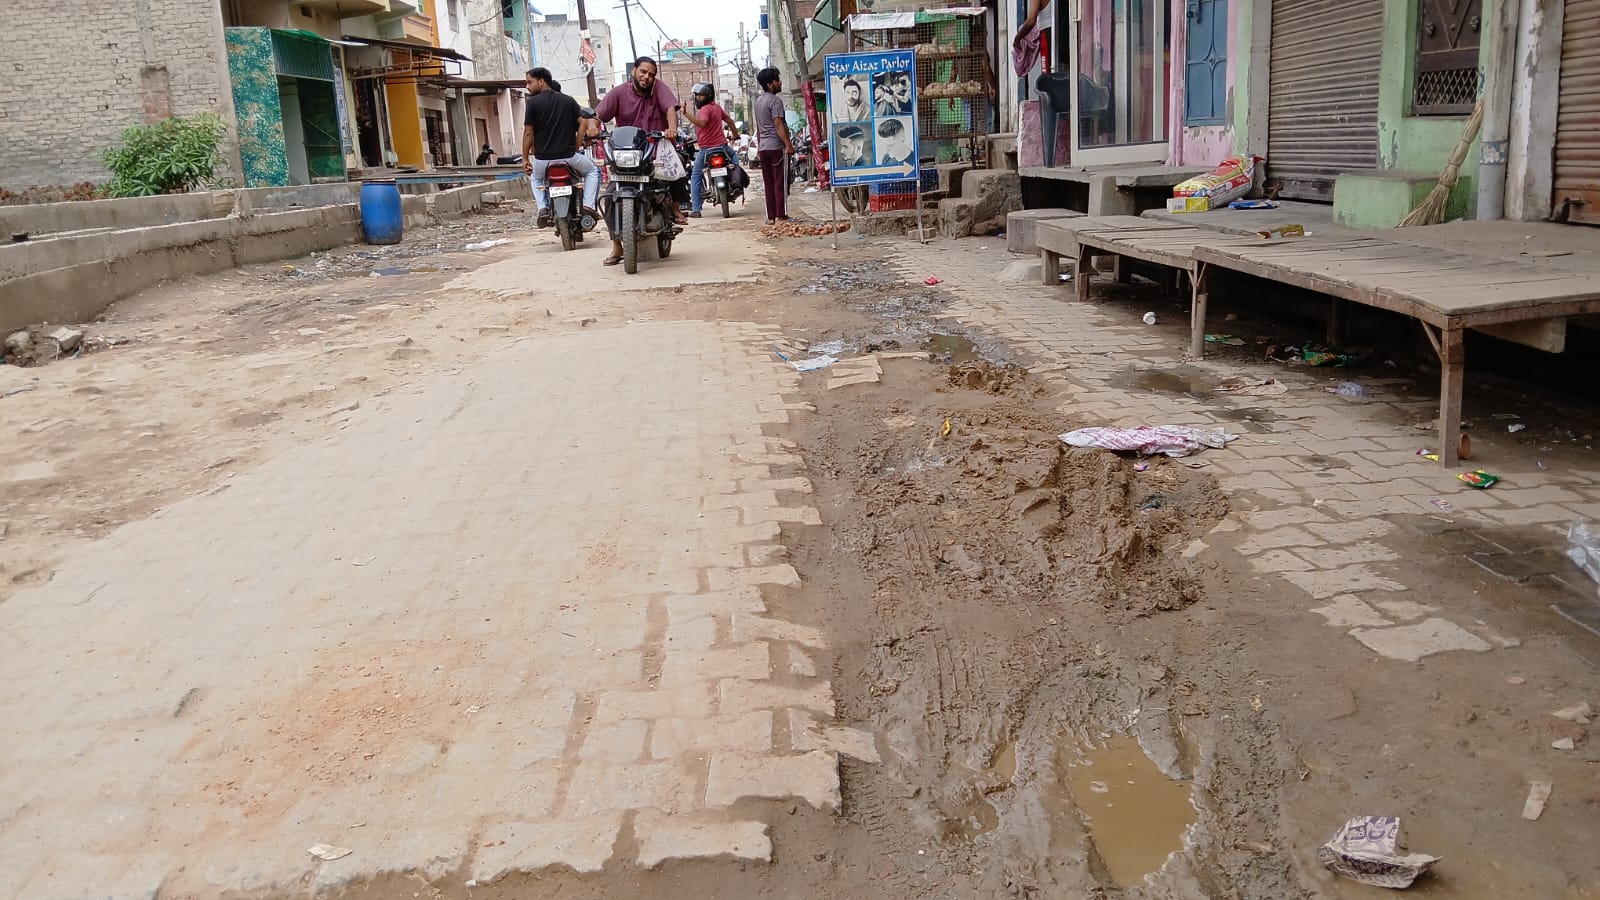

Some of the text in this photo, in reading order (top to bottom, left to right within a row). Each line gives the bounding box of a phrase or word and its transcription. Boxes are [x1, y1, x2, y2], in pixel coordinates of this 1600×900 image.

[829, 56, 910, 73] Star Aizaz Parlor
